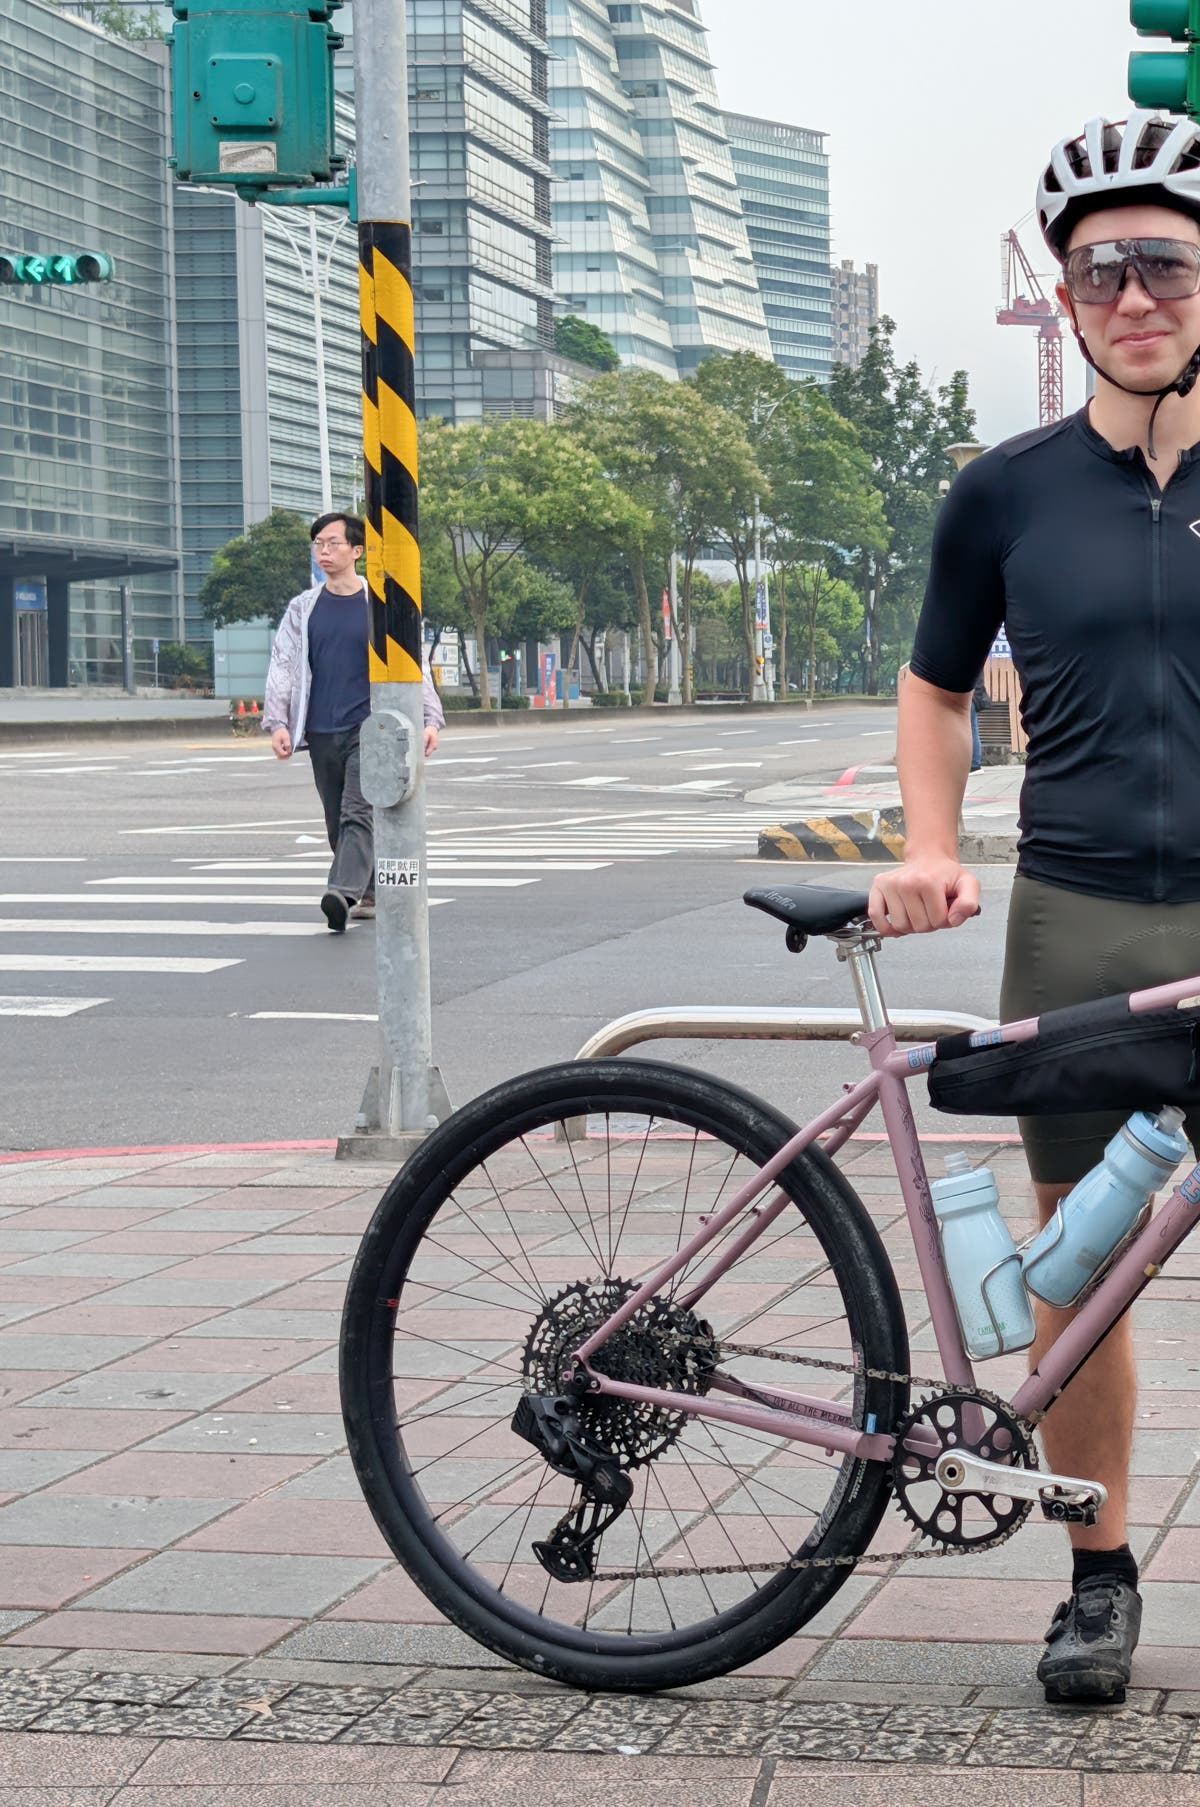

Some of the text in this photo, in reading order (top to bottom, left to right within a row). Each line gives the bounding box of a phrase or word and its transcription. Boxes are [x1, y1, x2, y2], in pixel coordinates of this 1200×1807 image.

[378, 860, 418, 871] 減肥就用
[378, 872, 418, 885] CHAF
